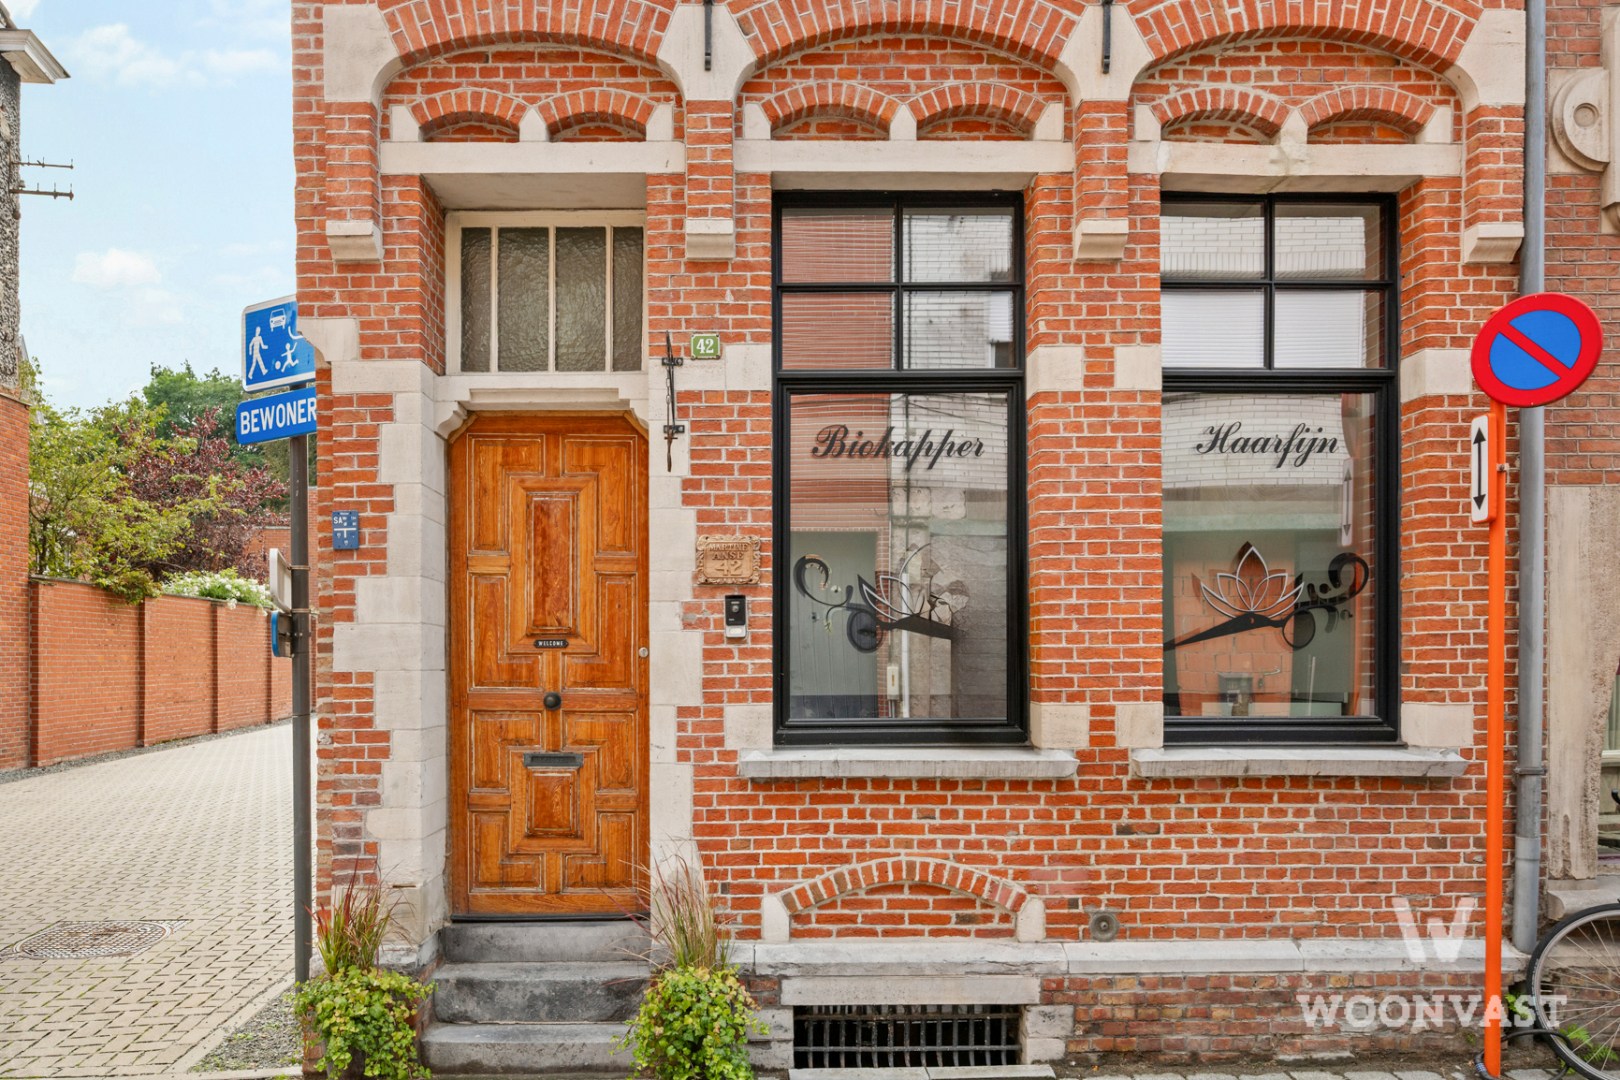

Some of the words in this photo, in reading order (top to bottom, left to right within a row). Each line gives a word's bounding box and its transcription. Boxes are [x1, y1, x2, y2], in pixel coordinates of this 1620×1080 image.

[696, 338, 714, 354] 42
[811, 424, 985, 472] Biokapper
[1196, 421, 1339, 468] Haarfijn
[715, 560, 743, 576] 42
